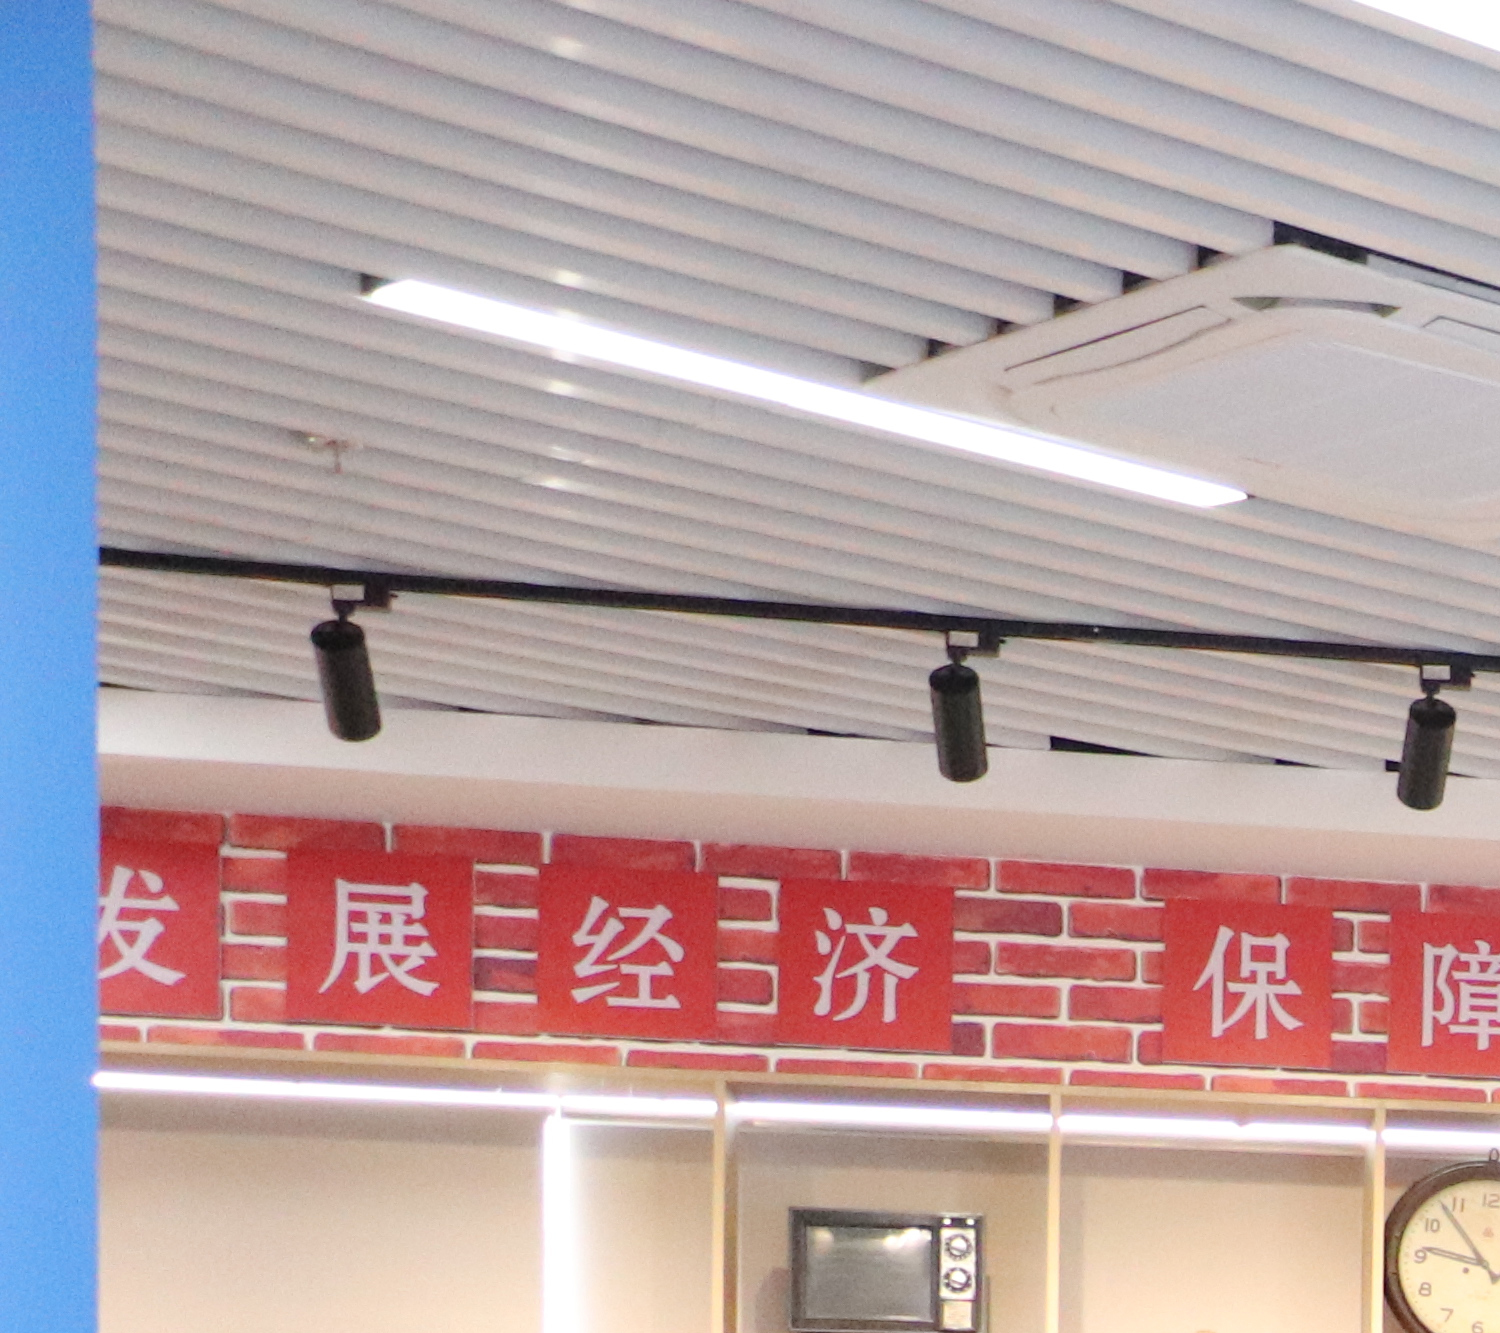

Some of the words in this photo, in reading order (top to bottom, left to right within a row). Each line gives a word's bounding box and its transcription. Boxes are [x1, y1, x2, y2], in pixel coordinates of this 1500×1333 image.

[98, 865, 918, 1023] 发展经济
[1452, 1197, 1465, 1213] 11
[1482, 1193, 1500, 1208] 12
[1425, 1218, 1440, 1233] 10
[1414, 1249, 1427, 1264] 9
[1418, 1282, 1432, 1297] 8
[1440, 1307, 1454, 1322] 7
